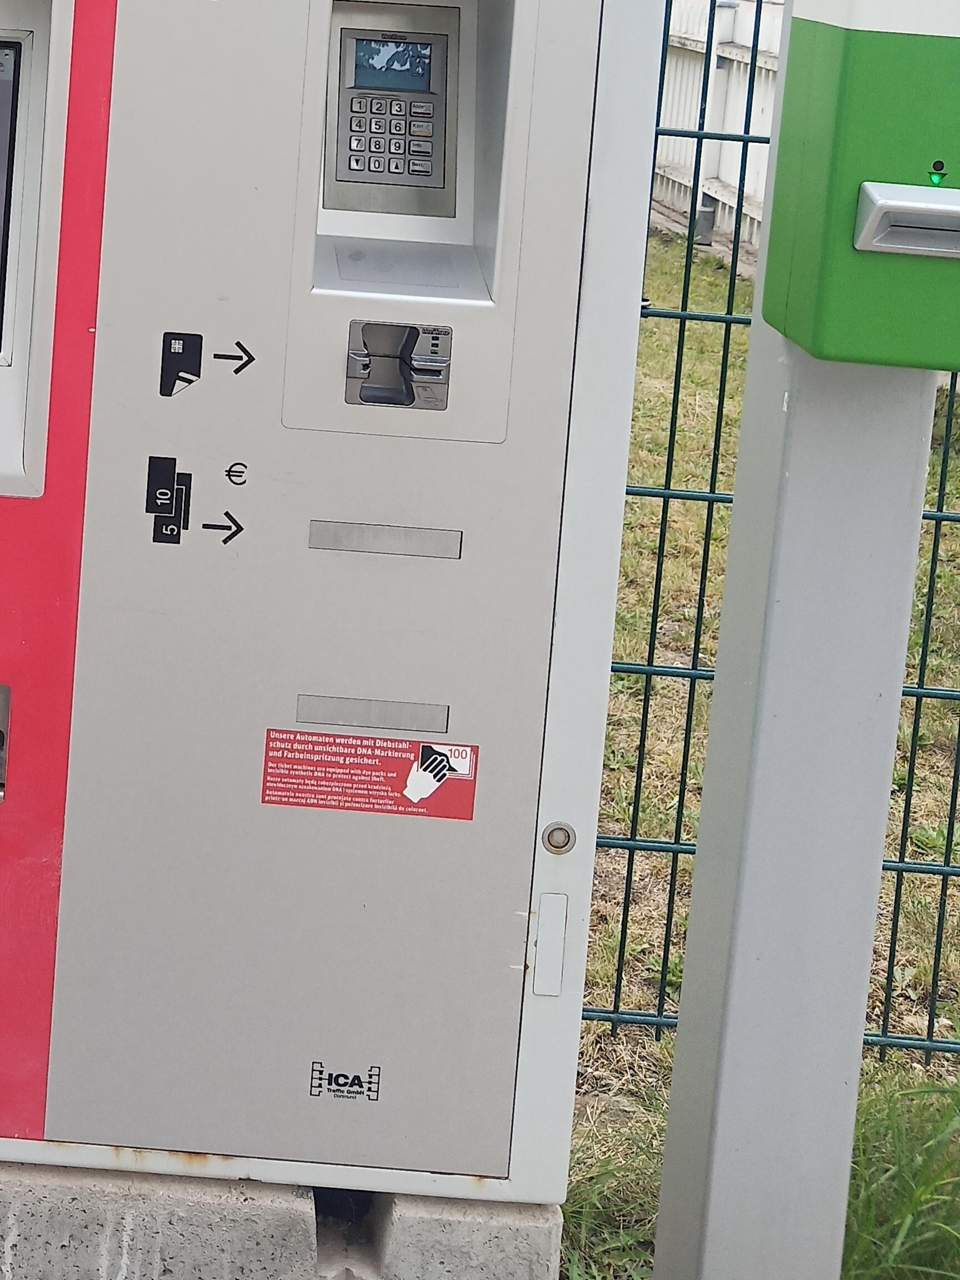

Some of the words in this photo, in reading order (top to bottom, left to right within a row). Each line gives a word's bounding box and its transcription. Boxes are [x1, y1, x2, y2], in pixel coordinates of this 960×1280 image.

[358, 101, 362, 110] 1
[376, 102, 382, 112] 2
[395, 103, 402, 112] 3
[355, 120, 362, 129] 4
[375, 121, 381, 130] 5
[395, 122, 401, 132] 6
[355, 139, 361, 148] 7
[374, 140, 381, 150] 8
[394, 142, 400, 151] 9
[374, 159, 380, 169] 0
[225, 462, 248, 486] €
[155, 489, 171, 505] 10
[162, 525, 178, 536] 5
[270, 731, 294, 740] Unsere
[296, 733, 334, 743] Automaten
[336, 736, 361, 746] werden
[363, 737, 374, 746] mit
[375, 737, 412, 749] Diebstahl-
[269, 741, 292, 750] schutz
[293, 742, 312, 751] durch
[314, 744, 355, 755] unsichtbare
[356, 747, 415, 760] DNA-Markierung
[448, 749, 468, 759] 100
[269, 750, 282, 758] und
[284, 751, 344, 764] Farbeinspritzung
[345, 755, 381, 766] gesichert.
[327, 1073, 364, 1088] ICA
